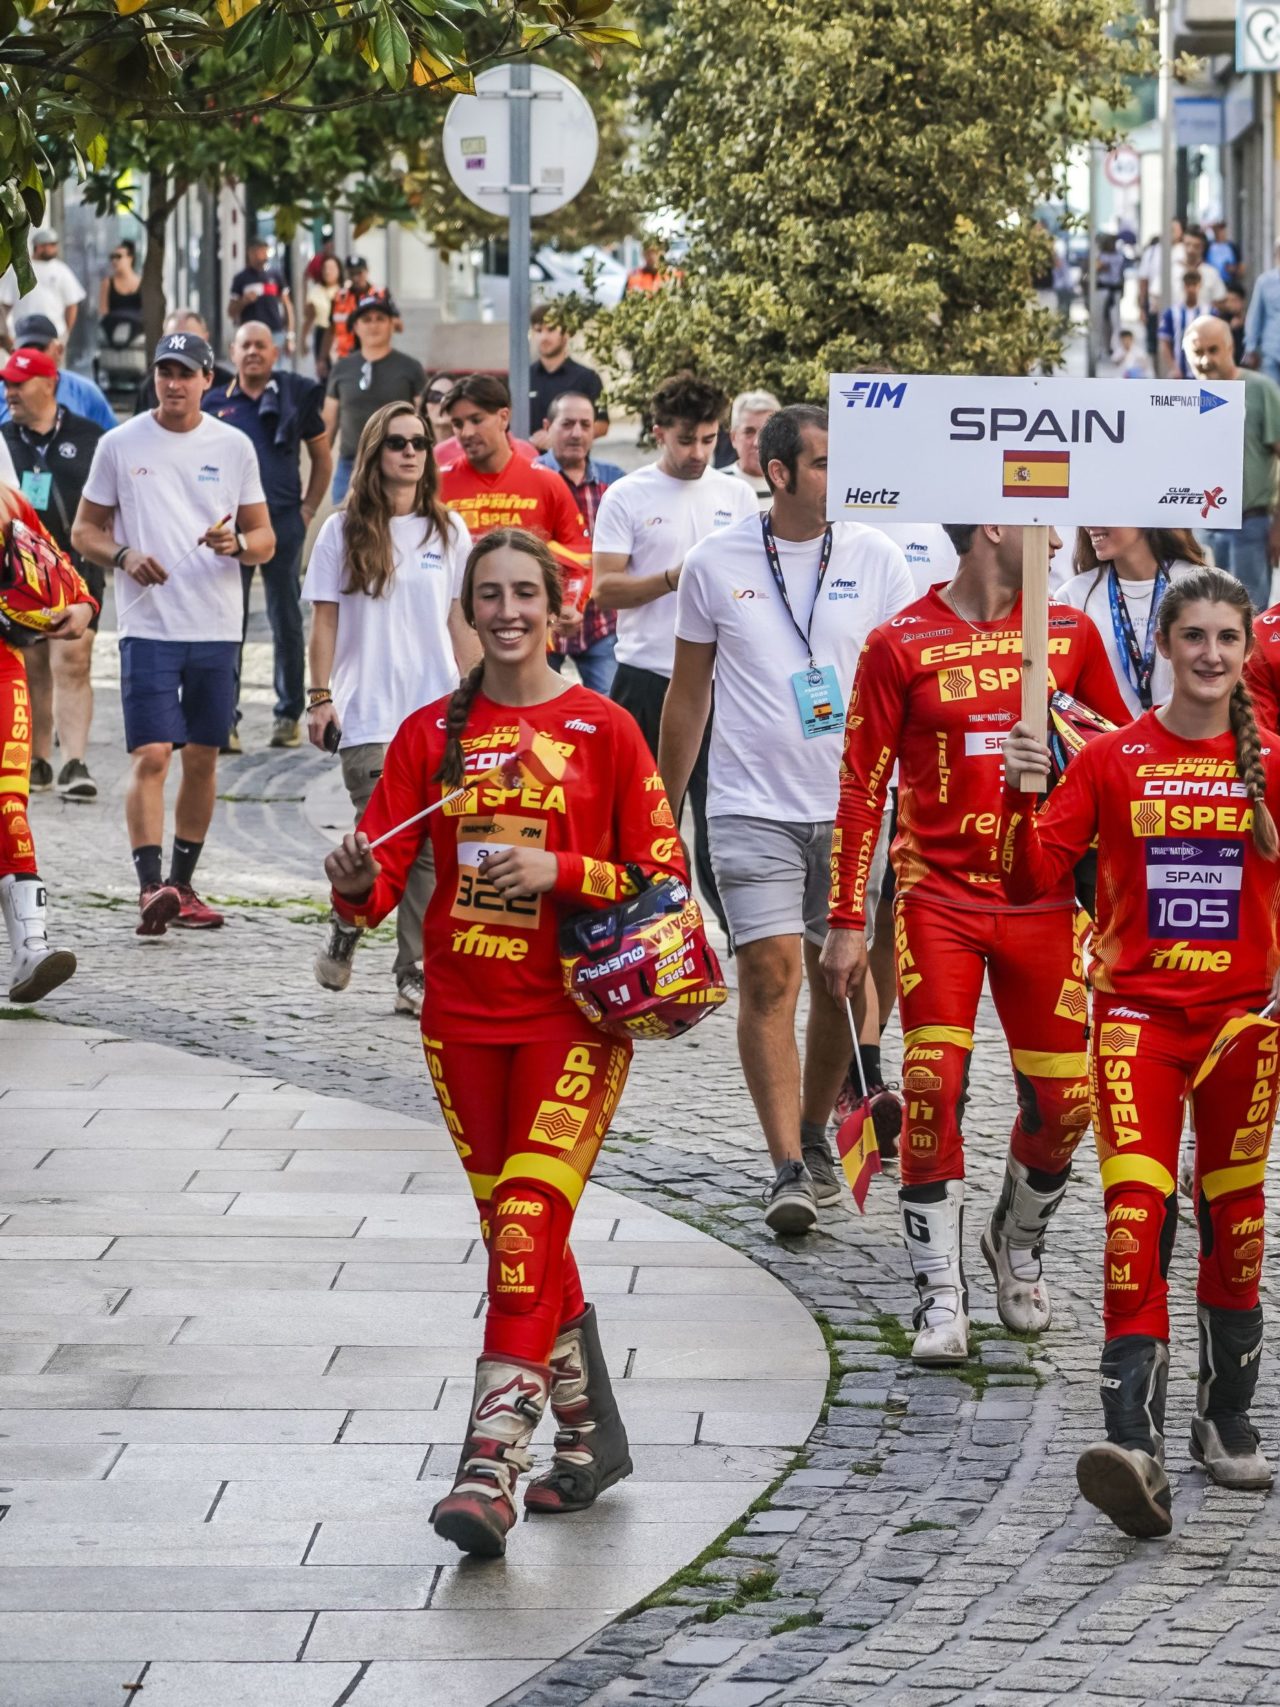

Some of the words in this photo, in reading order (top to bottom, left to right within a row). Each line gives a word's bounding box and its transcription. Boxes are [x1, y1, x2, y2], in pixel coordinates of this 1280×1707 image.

[840, 382, 908, 409] FIM
[1150, 395, 1174, 406] TRIAL
[1180, 396, 1218, 406] NATIONS
[950, 408, 1125, 444] SPAIN
[845, 488, 900, 505] Hertz
[1158, 487, 1227, 519] ARTEIXO
[480, 512, 522, 526] SPEA
[831, 578, 857, 588] rfme
[969, 631, 1021, 641] TEAM
[920, 637, 1071, 666] ESPAA
[493, 725, 520, 734] TEA
[565, 719, 597, 734] rfme
[1136, 760, 1240, 778] ESPAÑ
[1177, 757, 1218, 765] TEAM
[482, 784, 567, 814] SPEA
[1143, 780, 1249, 798] COMAS
[1169, 805, 1253, 833] SPEA
[520, 826, 543, 839] FIM
[1150, 847, 1166, 855] TRIAL
[1170, 847, 1195, 855] NATIONS
[1218, 848, 1240, 857] FIM
[852, 828, 873, 915] HONDA
[1166, 871, 1222, 883] SPAIN
[669, 884, 690, 903] fme
[1158, 898, 1230, 928] 105
[451, 924, 529, 962] rfme
[577, 945, 646, 983] QUERALT
[895, 912, 923, 997] SPEA
[1150, 941, 1232, 972] rfme
[656, 966, 685, 988] SPEA
[555, 1042, 602, 1101] SP
[1246, 1029, 1280, 1124] SPEA
[1063, 1083, 1091, 1100] rfm
[427, 1053, 473, 1160] SPEA
[1104, 1059, 1142, 1147] SPEA
[496, 1196, 544, 1217] rfme
[1107, 1203, 1148, 1222] rfme
[904, 1209, 931, 1244] G
[496, 1285, 535, 1293] COMAS
